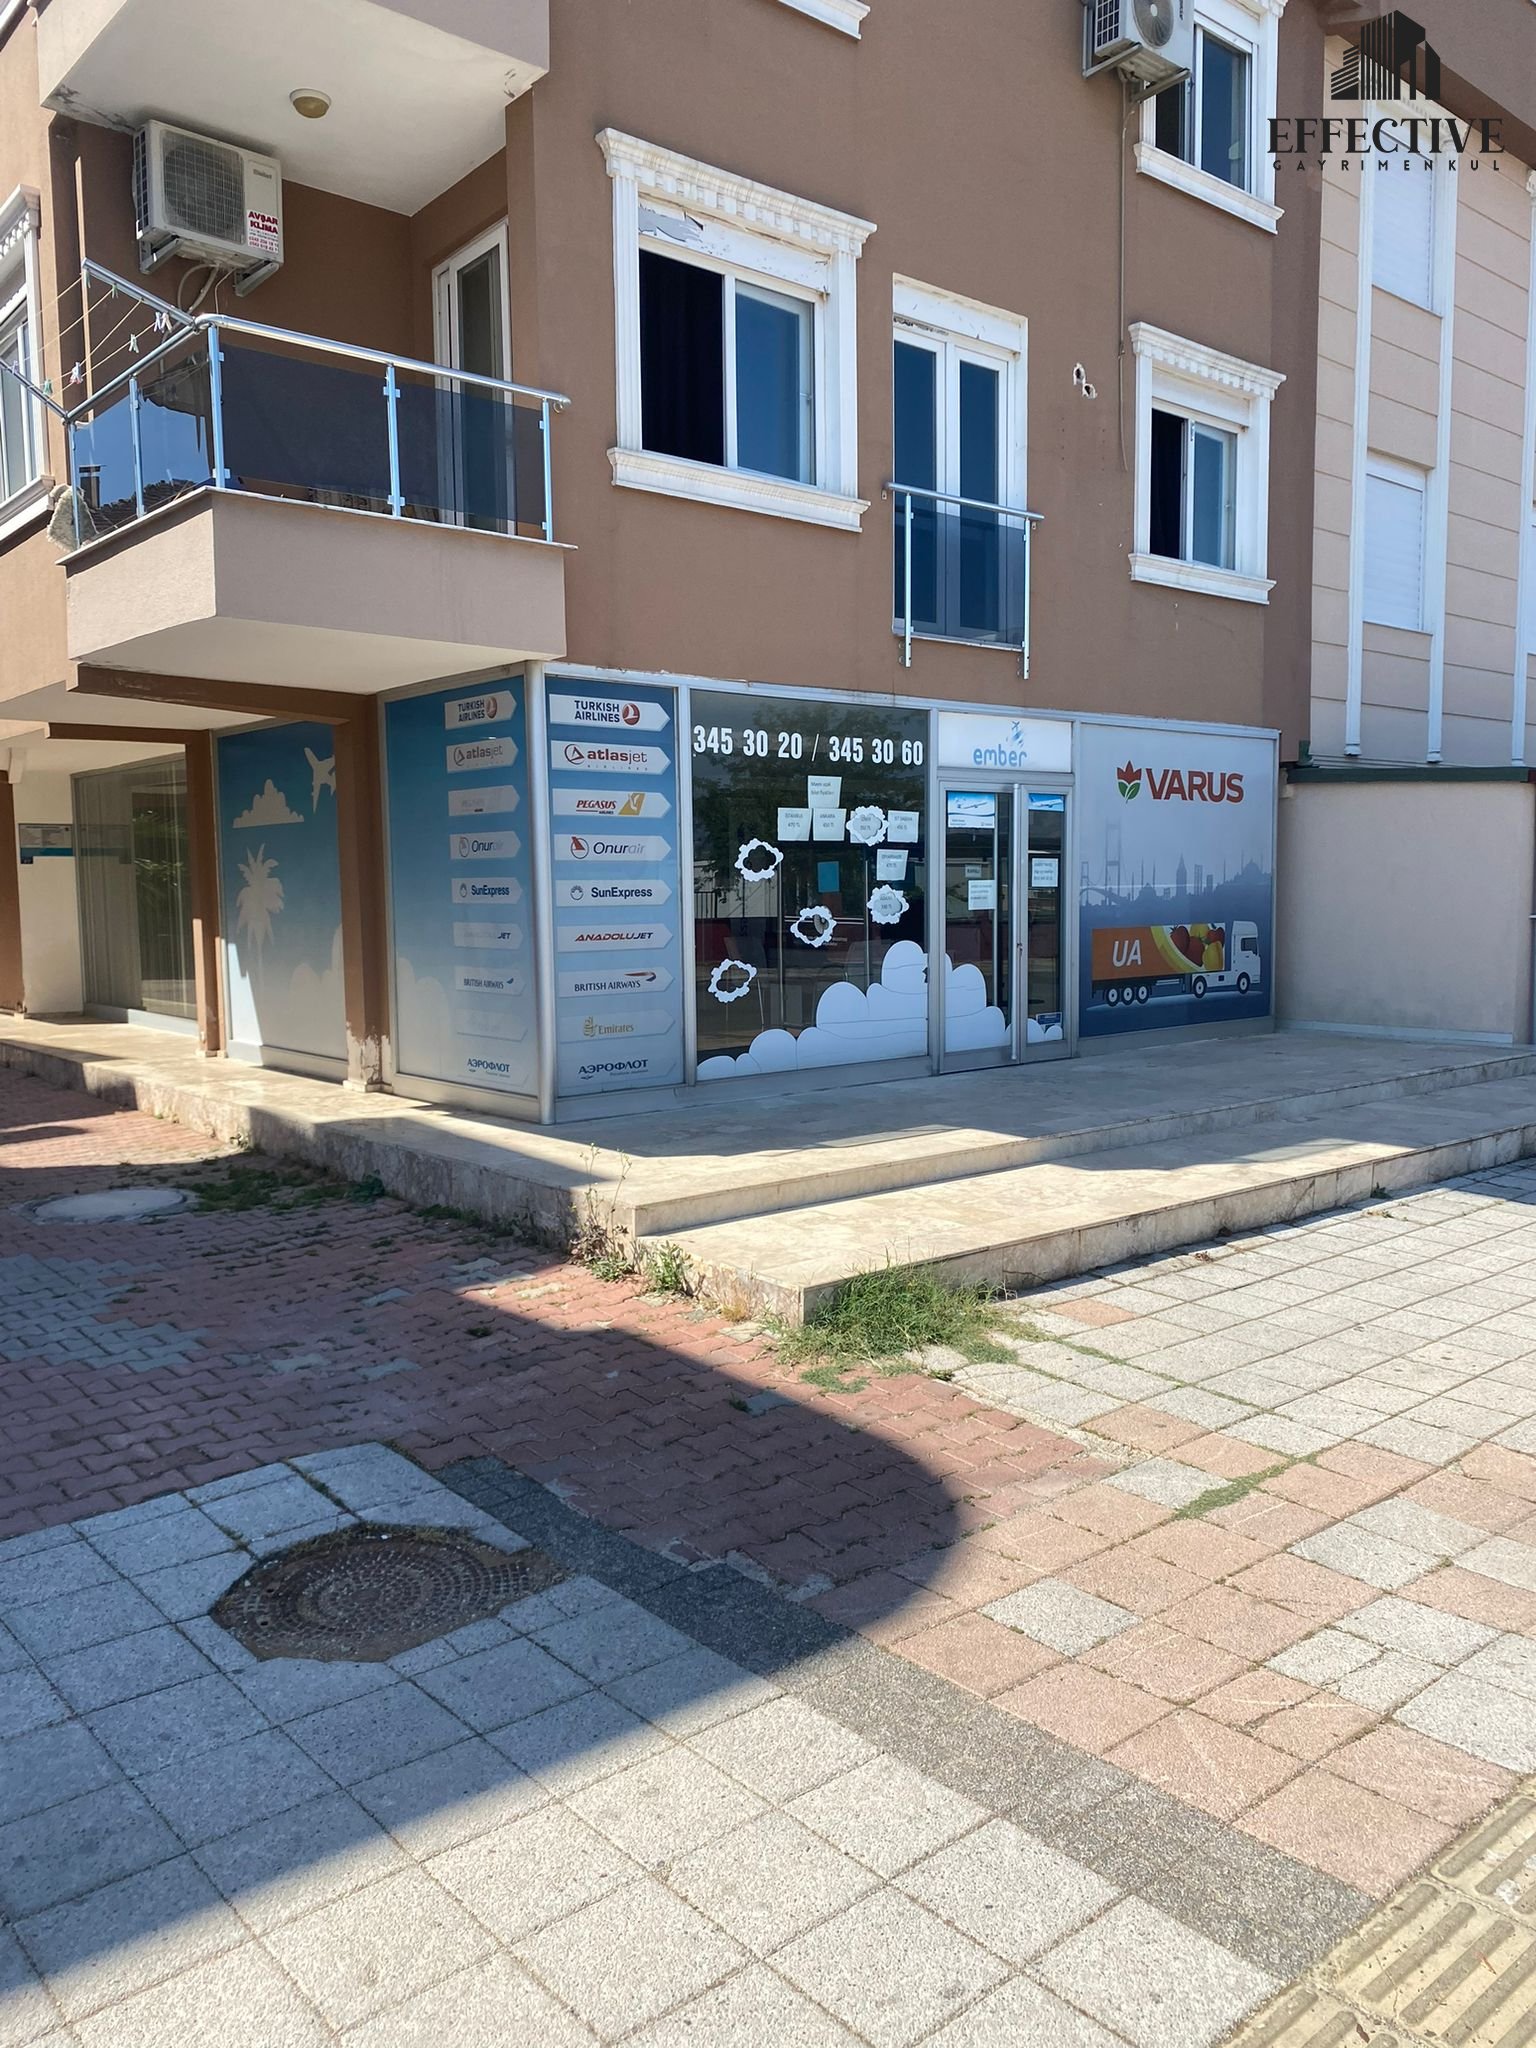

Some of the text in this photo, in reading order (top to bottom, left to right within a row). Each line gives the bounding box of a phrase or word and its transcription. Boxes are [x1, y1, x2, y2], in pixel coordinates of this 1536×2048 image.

[458, 700, 485, 713] TURKISH
[574, 700, 620, 712] TURKISH
[458, 710, 485, 722] AIRLINES
[574, 710, 620, 723] AIRLINES
[693, 725, 733, 755] 345
[743, 729, 768, 757] 30
[778, 732, 802, 759] 20
[829, 736, 863, 762] 345
[872, 739, 894, 764] 30
[902, 741, 923, 766] 60
[466, 745, 503, 760] atlasjet
[587, 749, 647, 764] atlasjet
[973, 744, 1027, 767] ember
[1146, 768, 1244, 803] VARUS
[576, 800, 616, 810] PEGASUS
[593, 842, 645, 854] Onurair
[471, 885, 510, 897] SunExpress
[591, 887, 652, 899] SunExpress
[575, 932, 653, 942] ANADOLUJET
[1112, 940, 1142, 967] UA
[464, 978, 482, 987] BRITISH
[574, 981, 640, 992] BRITISH AIRWAYS
[598, 1024, 634, 1034] Emirates
[467, 1058, 510, 1073] АЭРОФЛОТ
[578, 1059, 648, 1074] АЭРОФЛОТ
